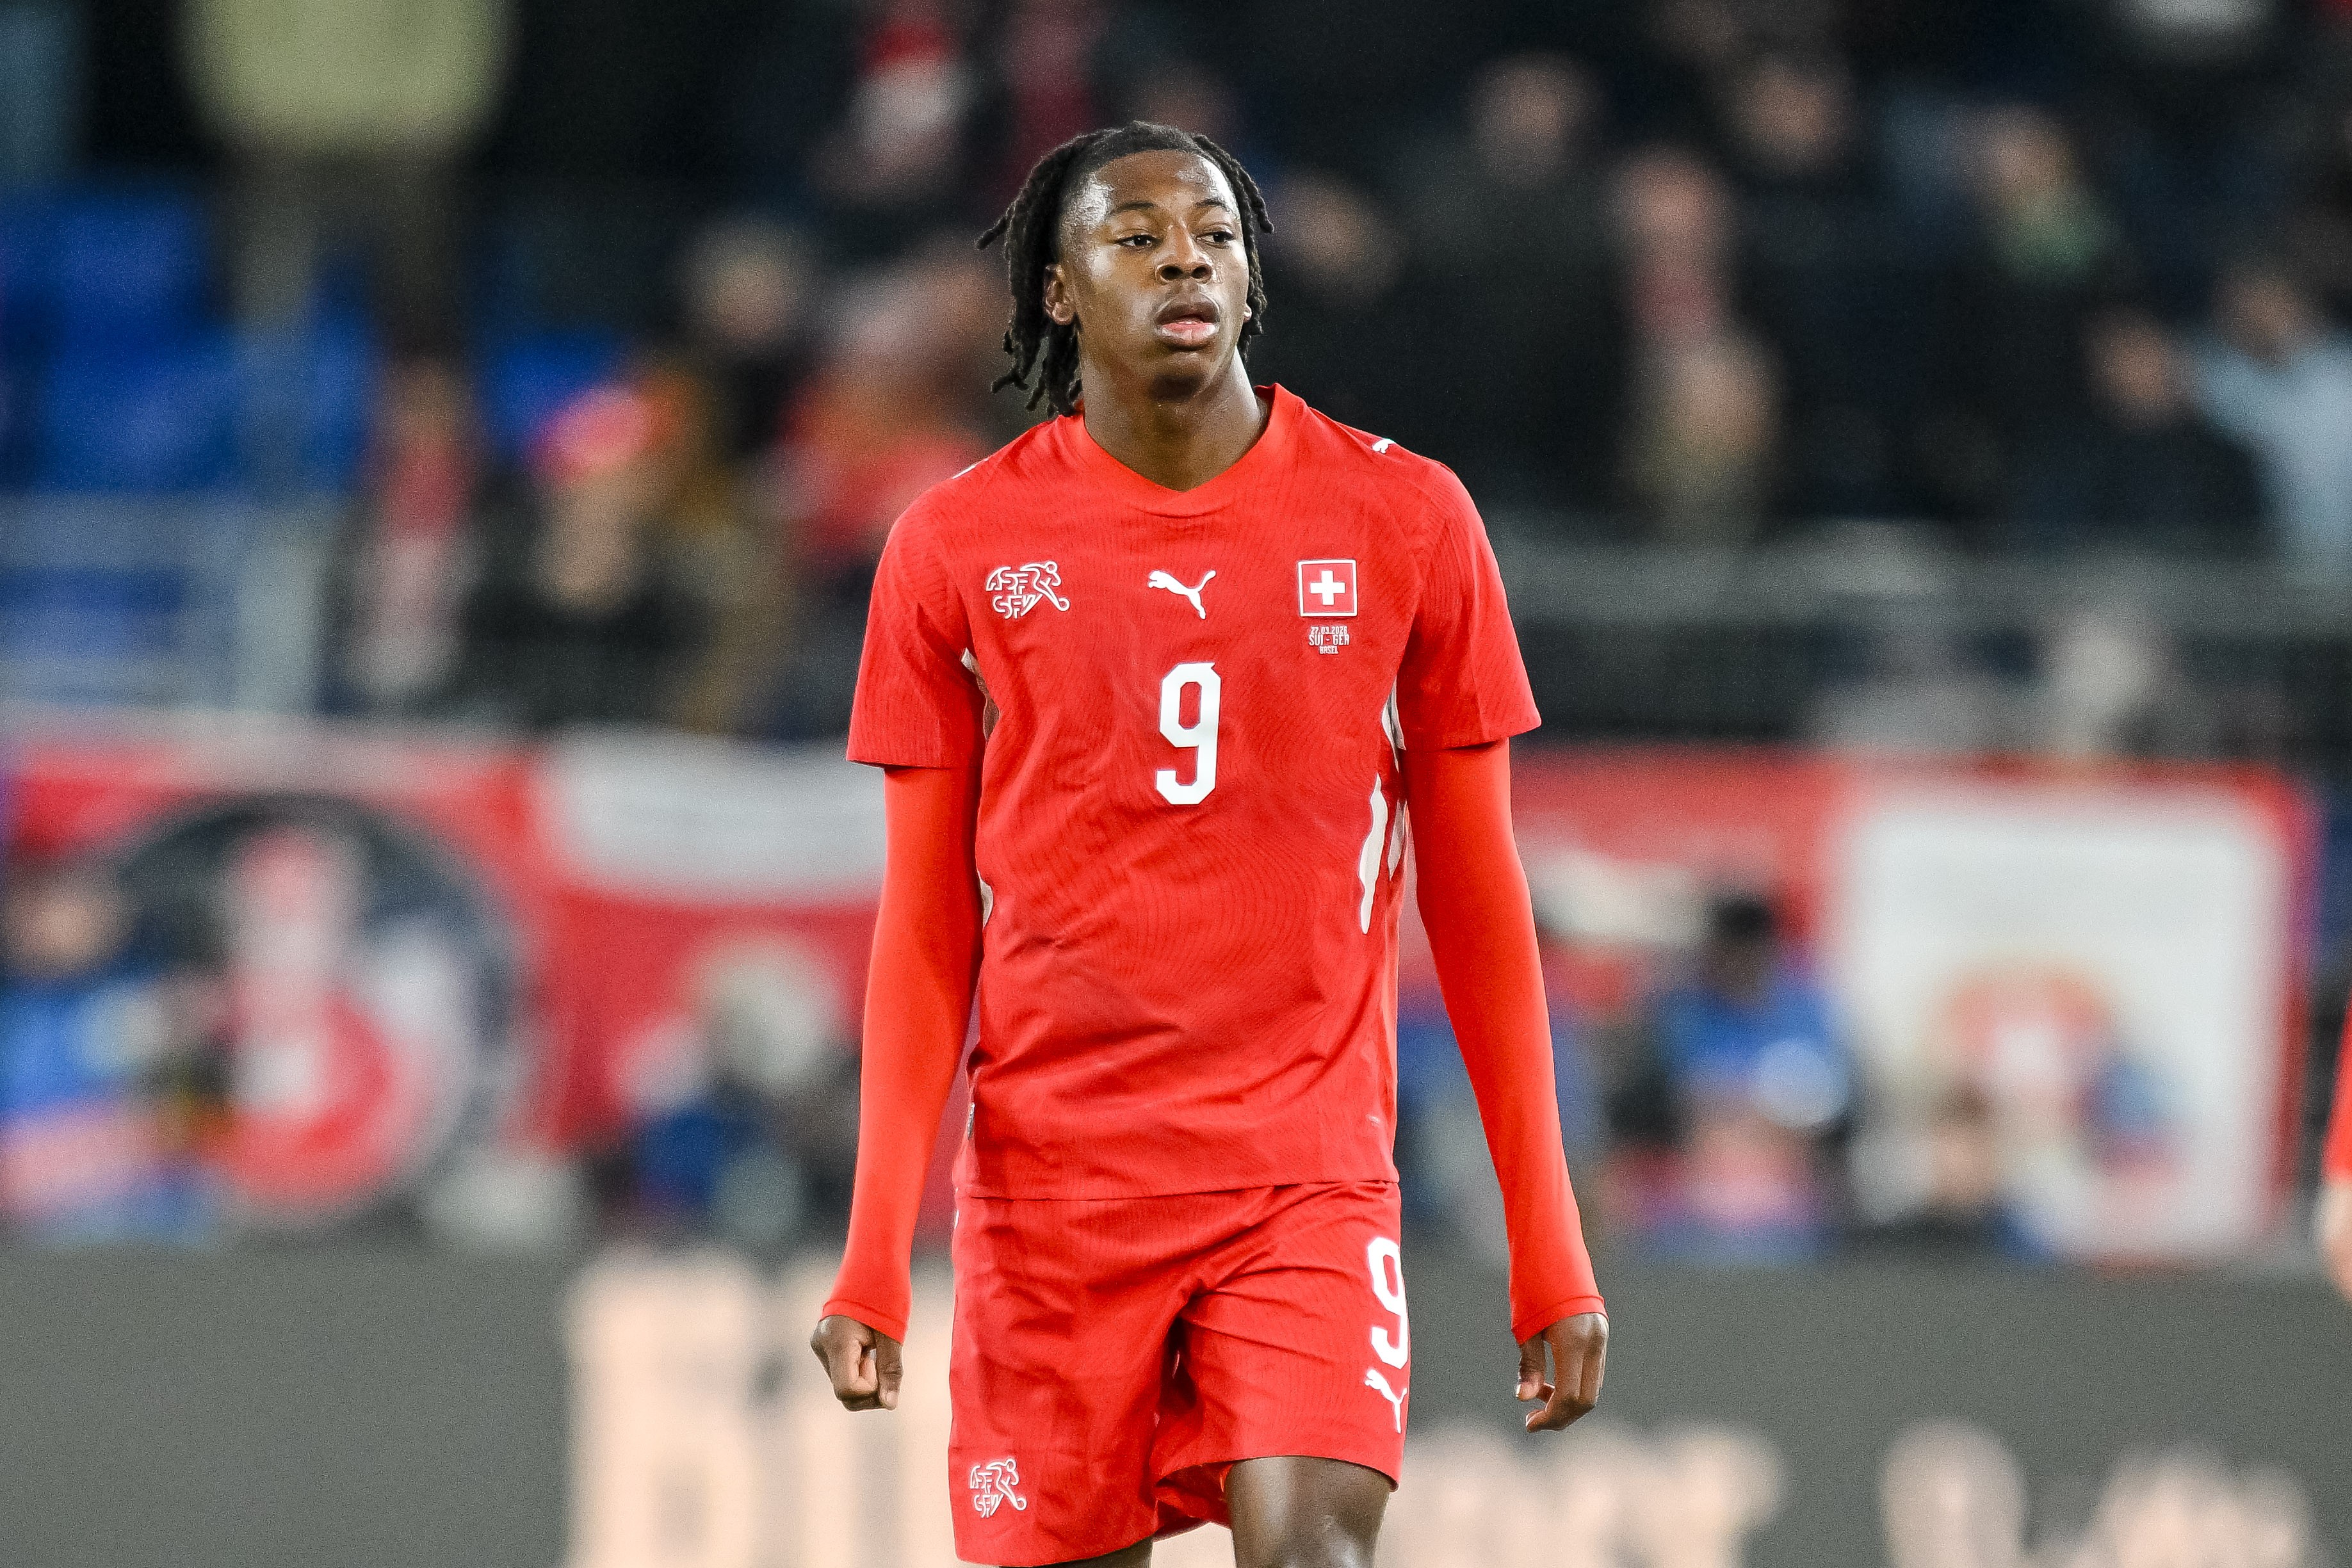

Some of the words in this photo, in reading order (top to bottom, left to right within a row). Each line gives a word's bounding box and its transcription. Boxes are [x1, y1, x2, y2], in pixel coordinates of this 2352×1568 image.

[1309, 634, 1324, 646] SUI
[1333, 634, 1350, 645] GER
[1319, 645, 1339, 654] BASEL
[1156, 662, 1221, 805] 9
[1367, 1236, 1408, 1370] 9
